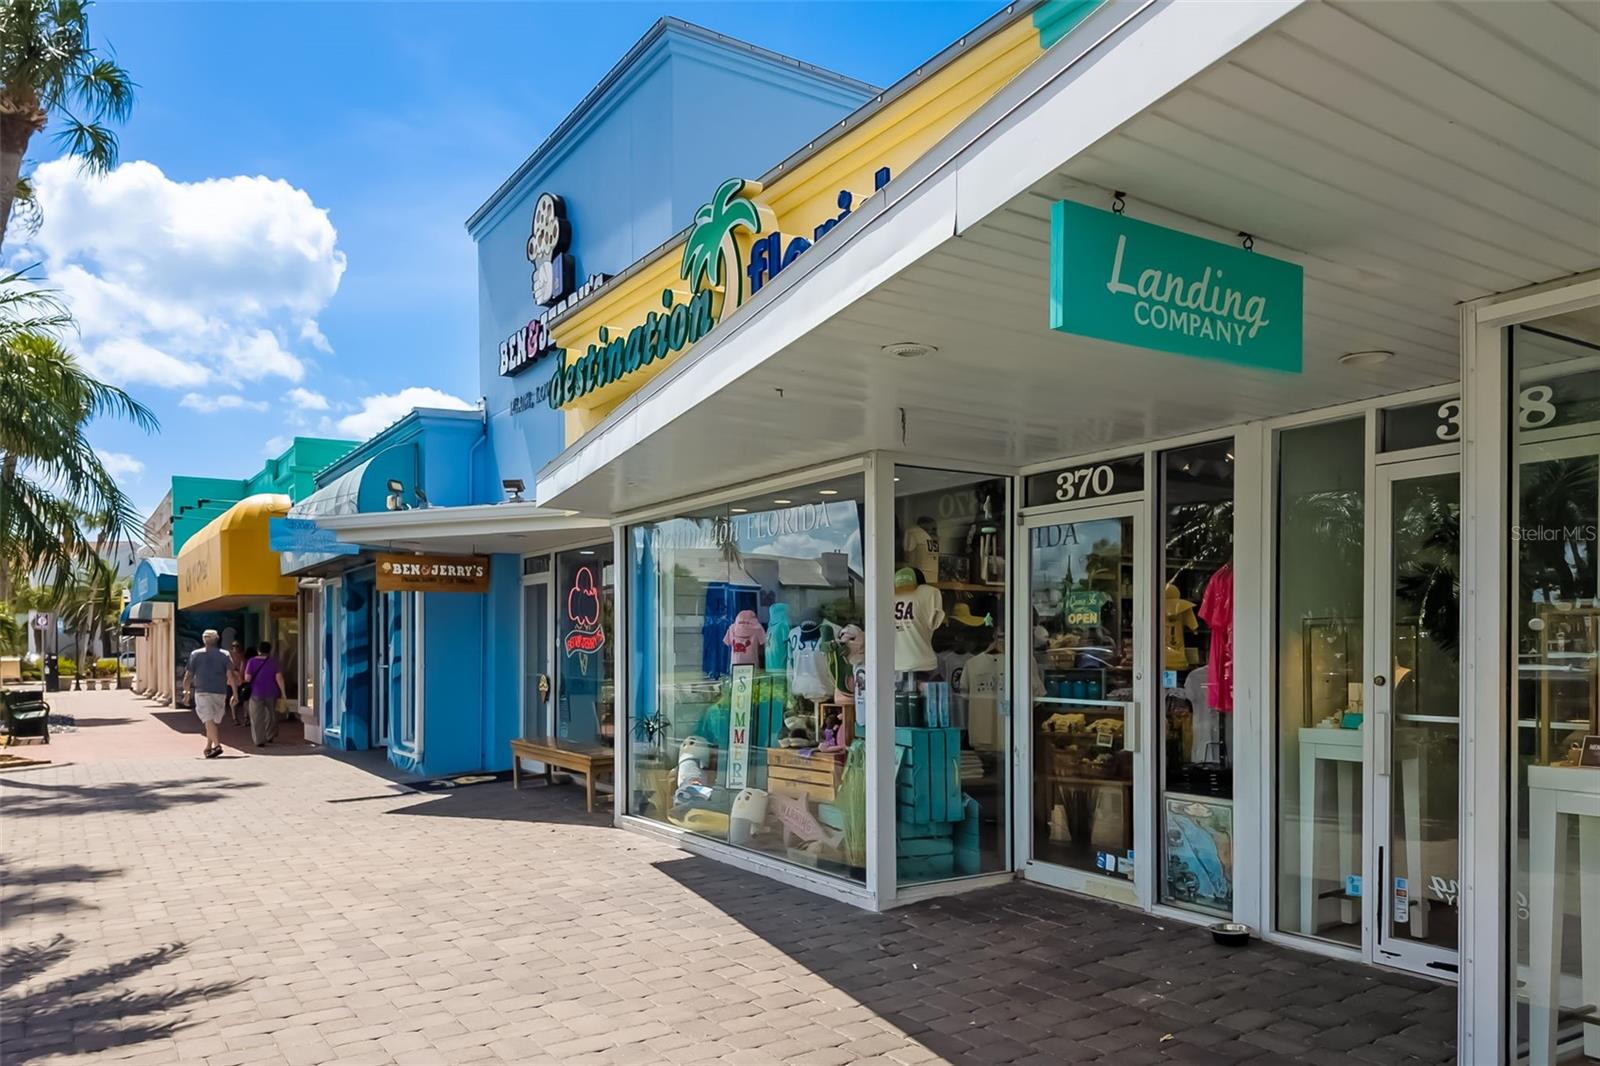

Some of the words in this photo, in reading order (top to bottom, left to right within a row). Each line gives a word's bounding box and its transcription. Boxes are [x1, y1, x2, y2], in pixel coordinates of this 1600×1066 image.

[1106, 233, 1269, 339] Landing
[1134, 301, 1246, 347] COMPANY
[549, 289, 714, 410] destination
[1056, 465, 1114, 501] 370
[744, 501, 833, 541] FLORIDA
[895, 601, 914, 621] SA
[1068, 613, 1098, 625] OPEN
[731, 675, 748, 779] SUMMER
